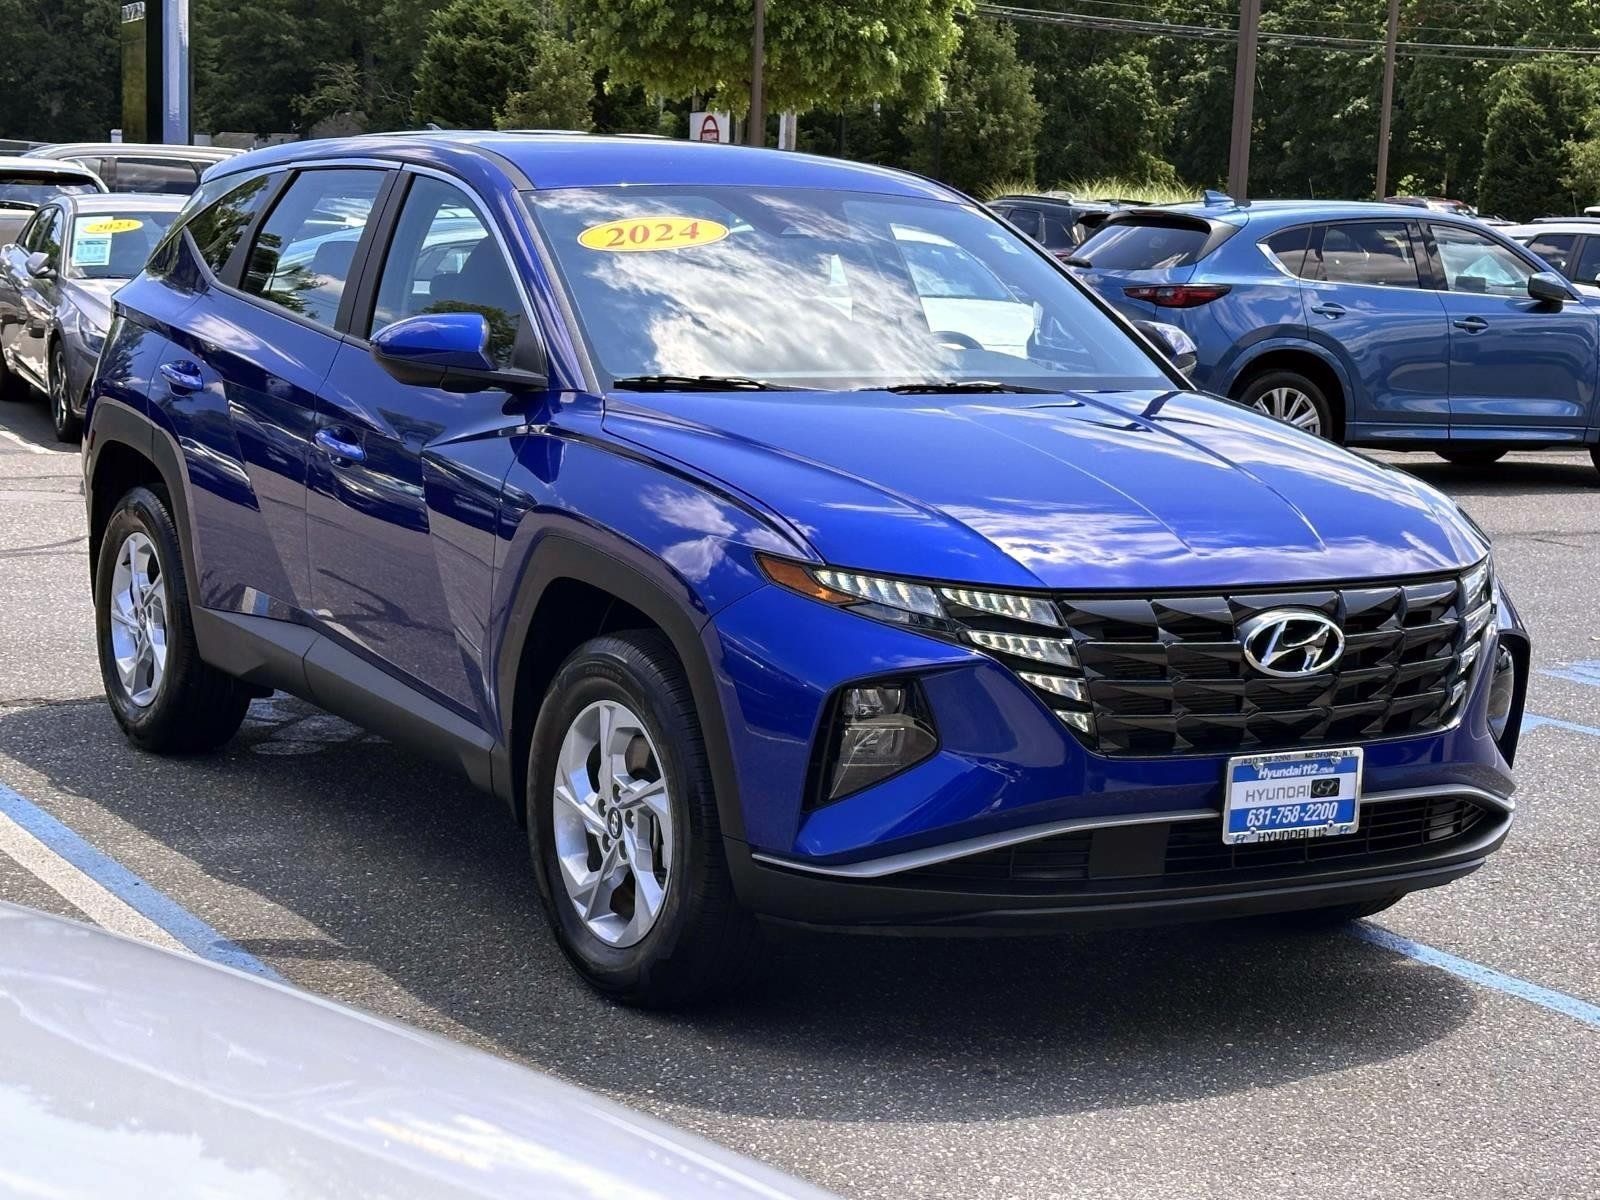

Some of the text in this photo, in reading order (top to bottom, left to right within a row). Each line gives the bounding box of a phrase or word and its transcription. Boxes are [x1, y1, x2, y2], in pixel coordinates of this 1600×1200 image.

[605, 221, 700, 248] 2024
[1245, 785, 1310, 802] HYUNDAI
[1246, 802, 1339, 827] 631-758-2200
[1257, 827, 1328, 842] HYUNDAI 112
